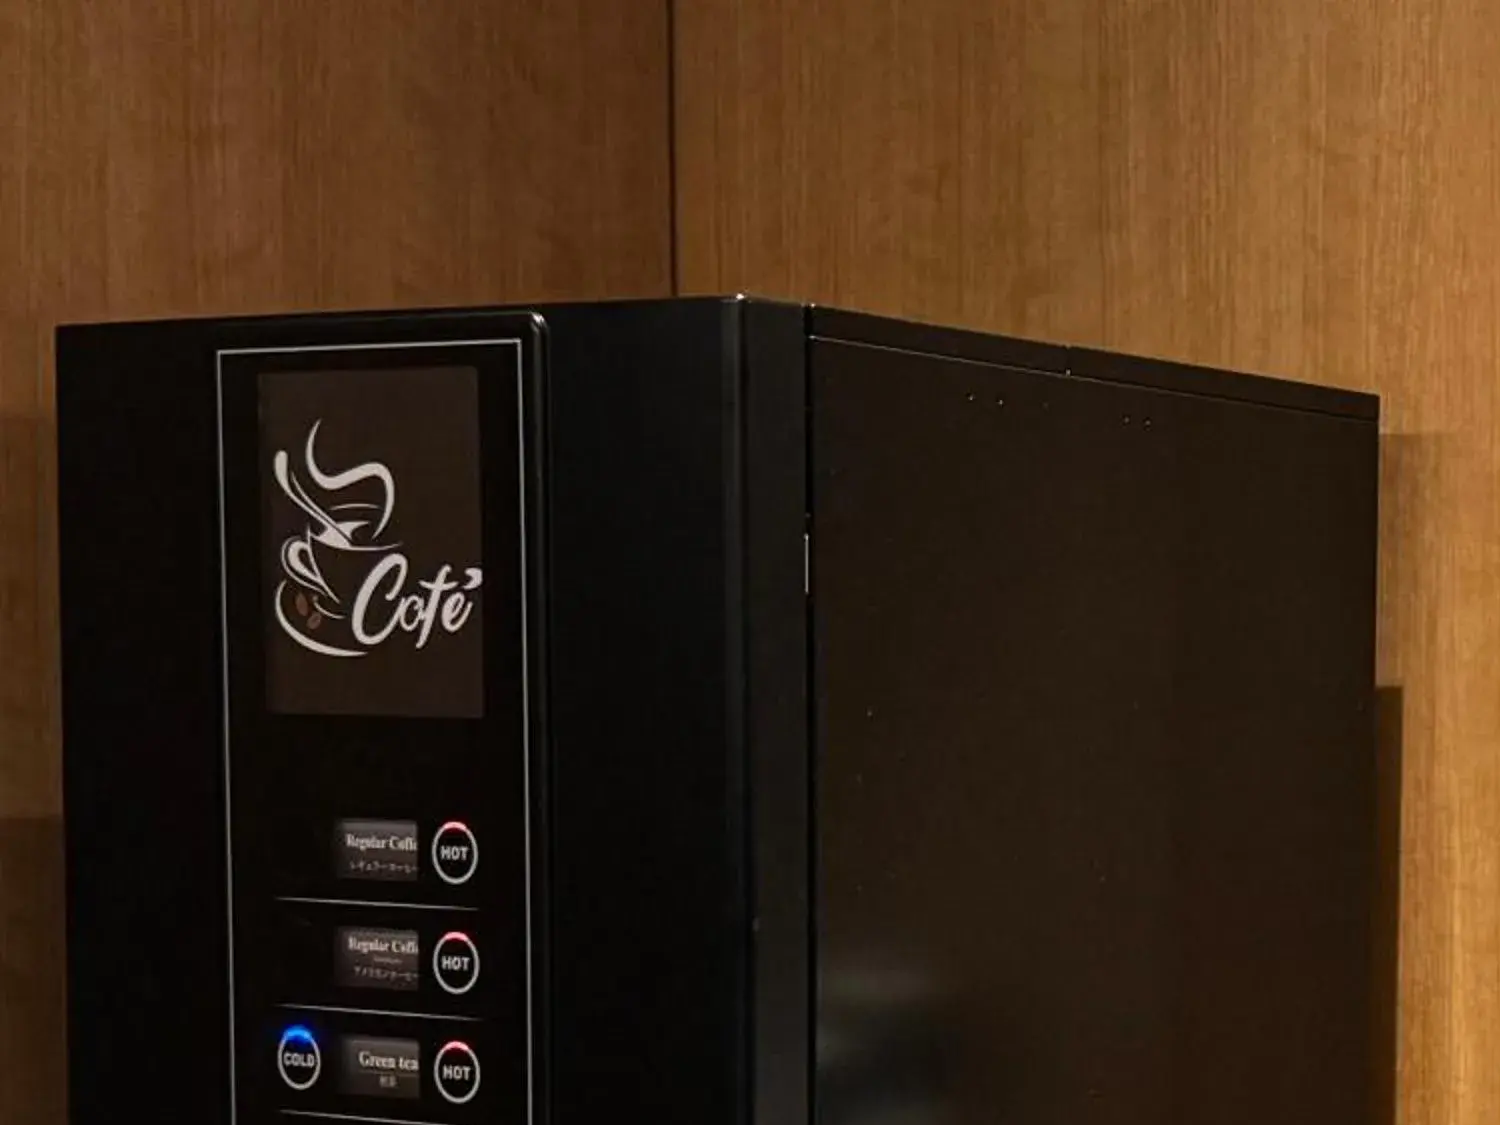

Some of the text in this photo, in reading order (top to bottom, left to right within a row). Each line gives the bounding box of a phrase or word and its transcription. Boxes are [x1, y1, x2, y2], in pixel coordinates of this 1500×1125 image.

[345, 833, 387, 851] Regular
[440, 845, 468, 861] HOT
[348, 935, 390, 954] Regular
[440, 955, 470, 971] HOT
[283, 1052, 315, 1068] COLD
[358, 1050, 419, 1072] Green tea
[442, 1066, 471, 1081] HOT
